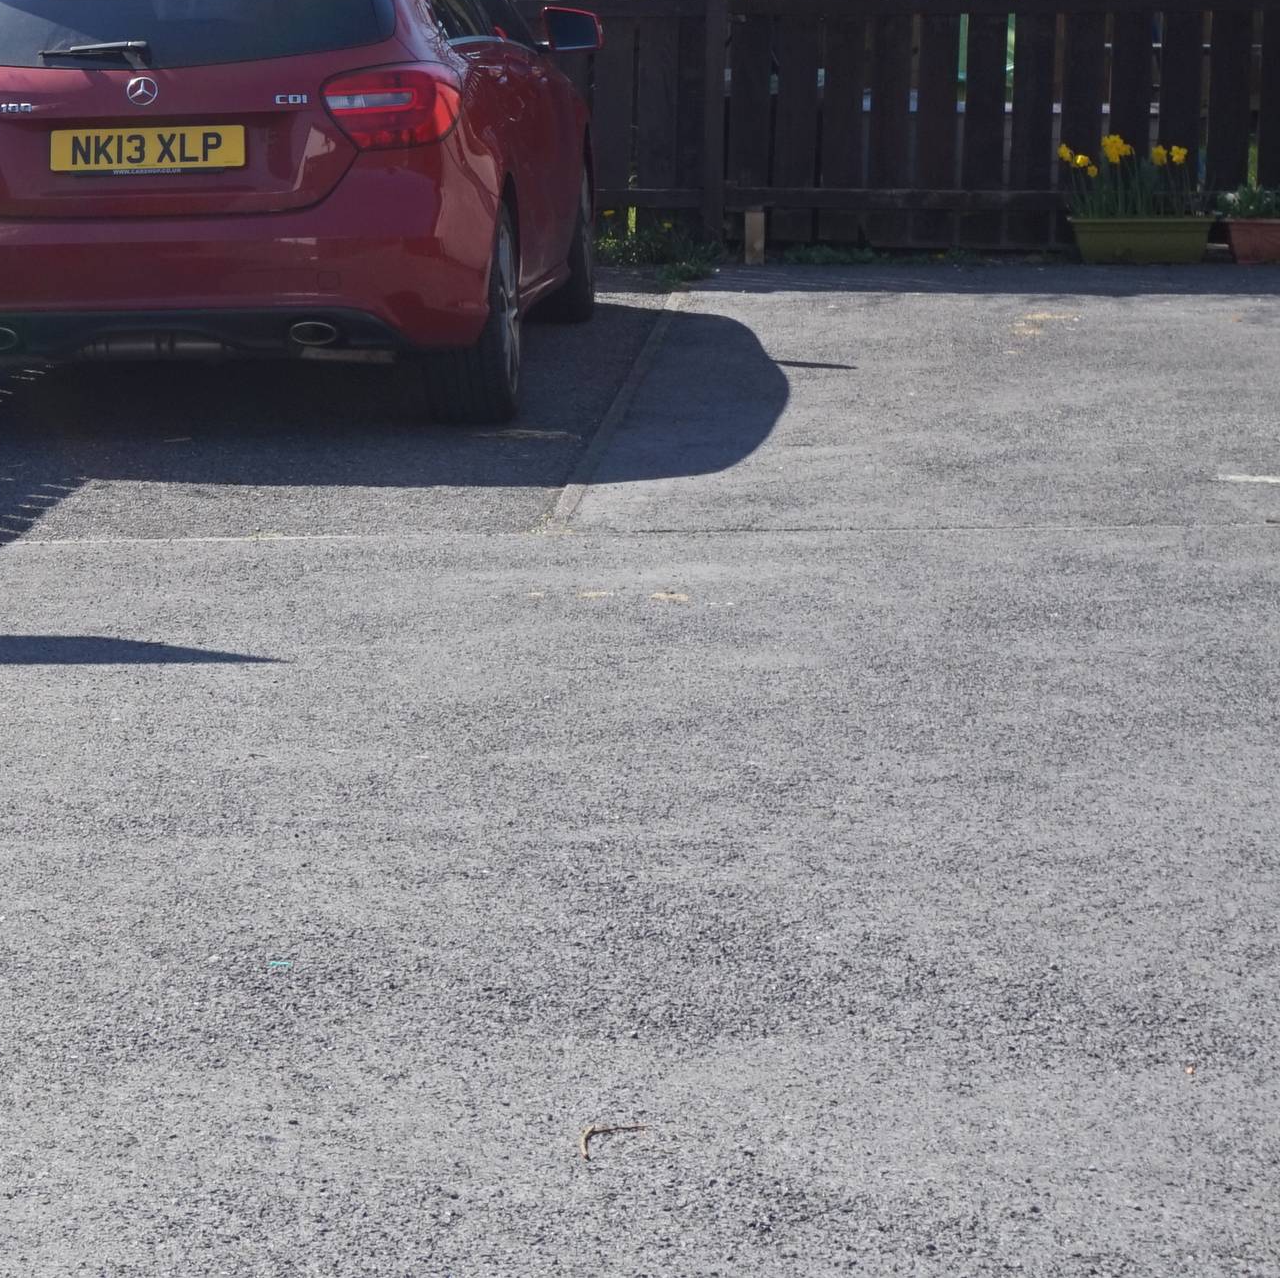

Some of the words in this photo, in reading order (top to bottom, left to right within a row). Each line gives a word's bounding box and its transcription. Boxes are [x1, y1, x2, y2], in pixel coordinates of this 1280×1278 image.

[275, 94, 308, 105] CDI
[72, 135, 146, 165] NK13
[157, 132, 222, 163] XLP
